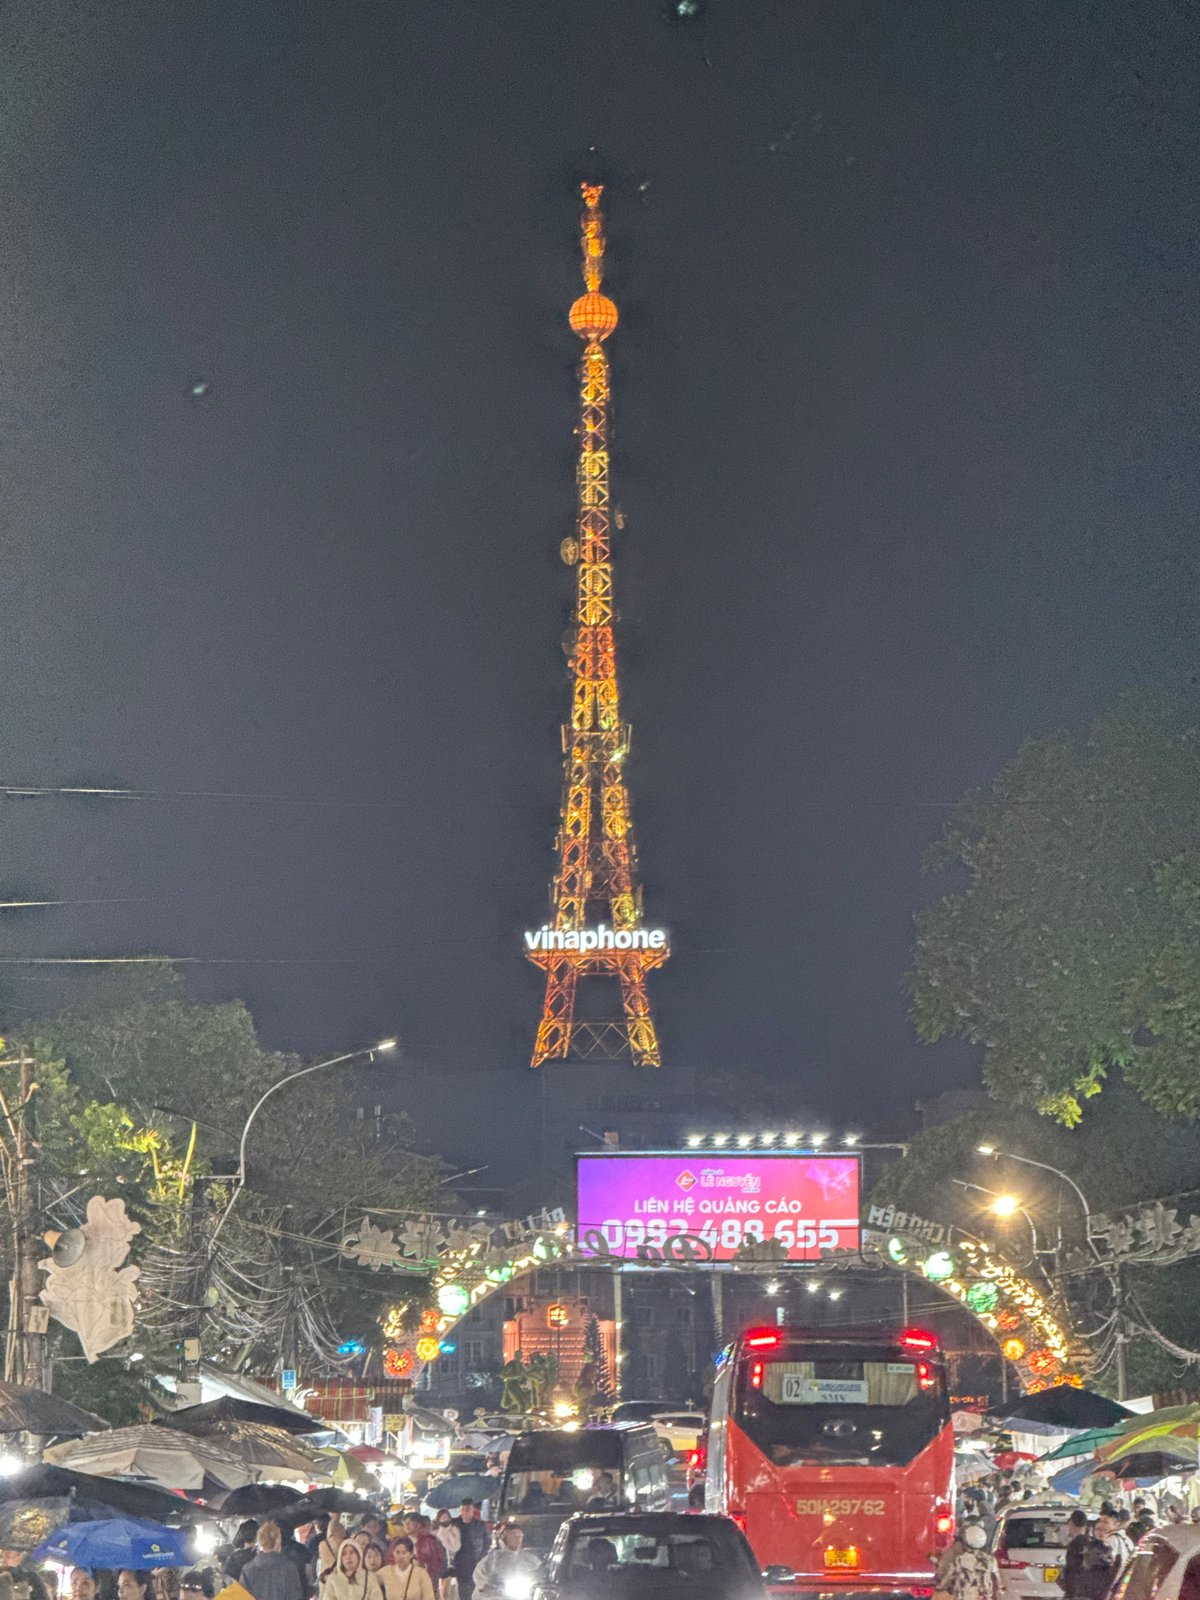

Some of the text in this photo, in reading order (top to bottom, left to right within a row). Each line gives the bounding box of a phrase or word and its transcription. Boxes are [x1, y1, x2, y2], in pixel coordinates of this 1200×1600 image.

[524, 924, 666, 954] vinaphone
[634, 1196, 802, 1216] LIÊN HỆ QUẢNG CÁO
[785, 1379, 801, 1398] 02
